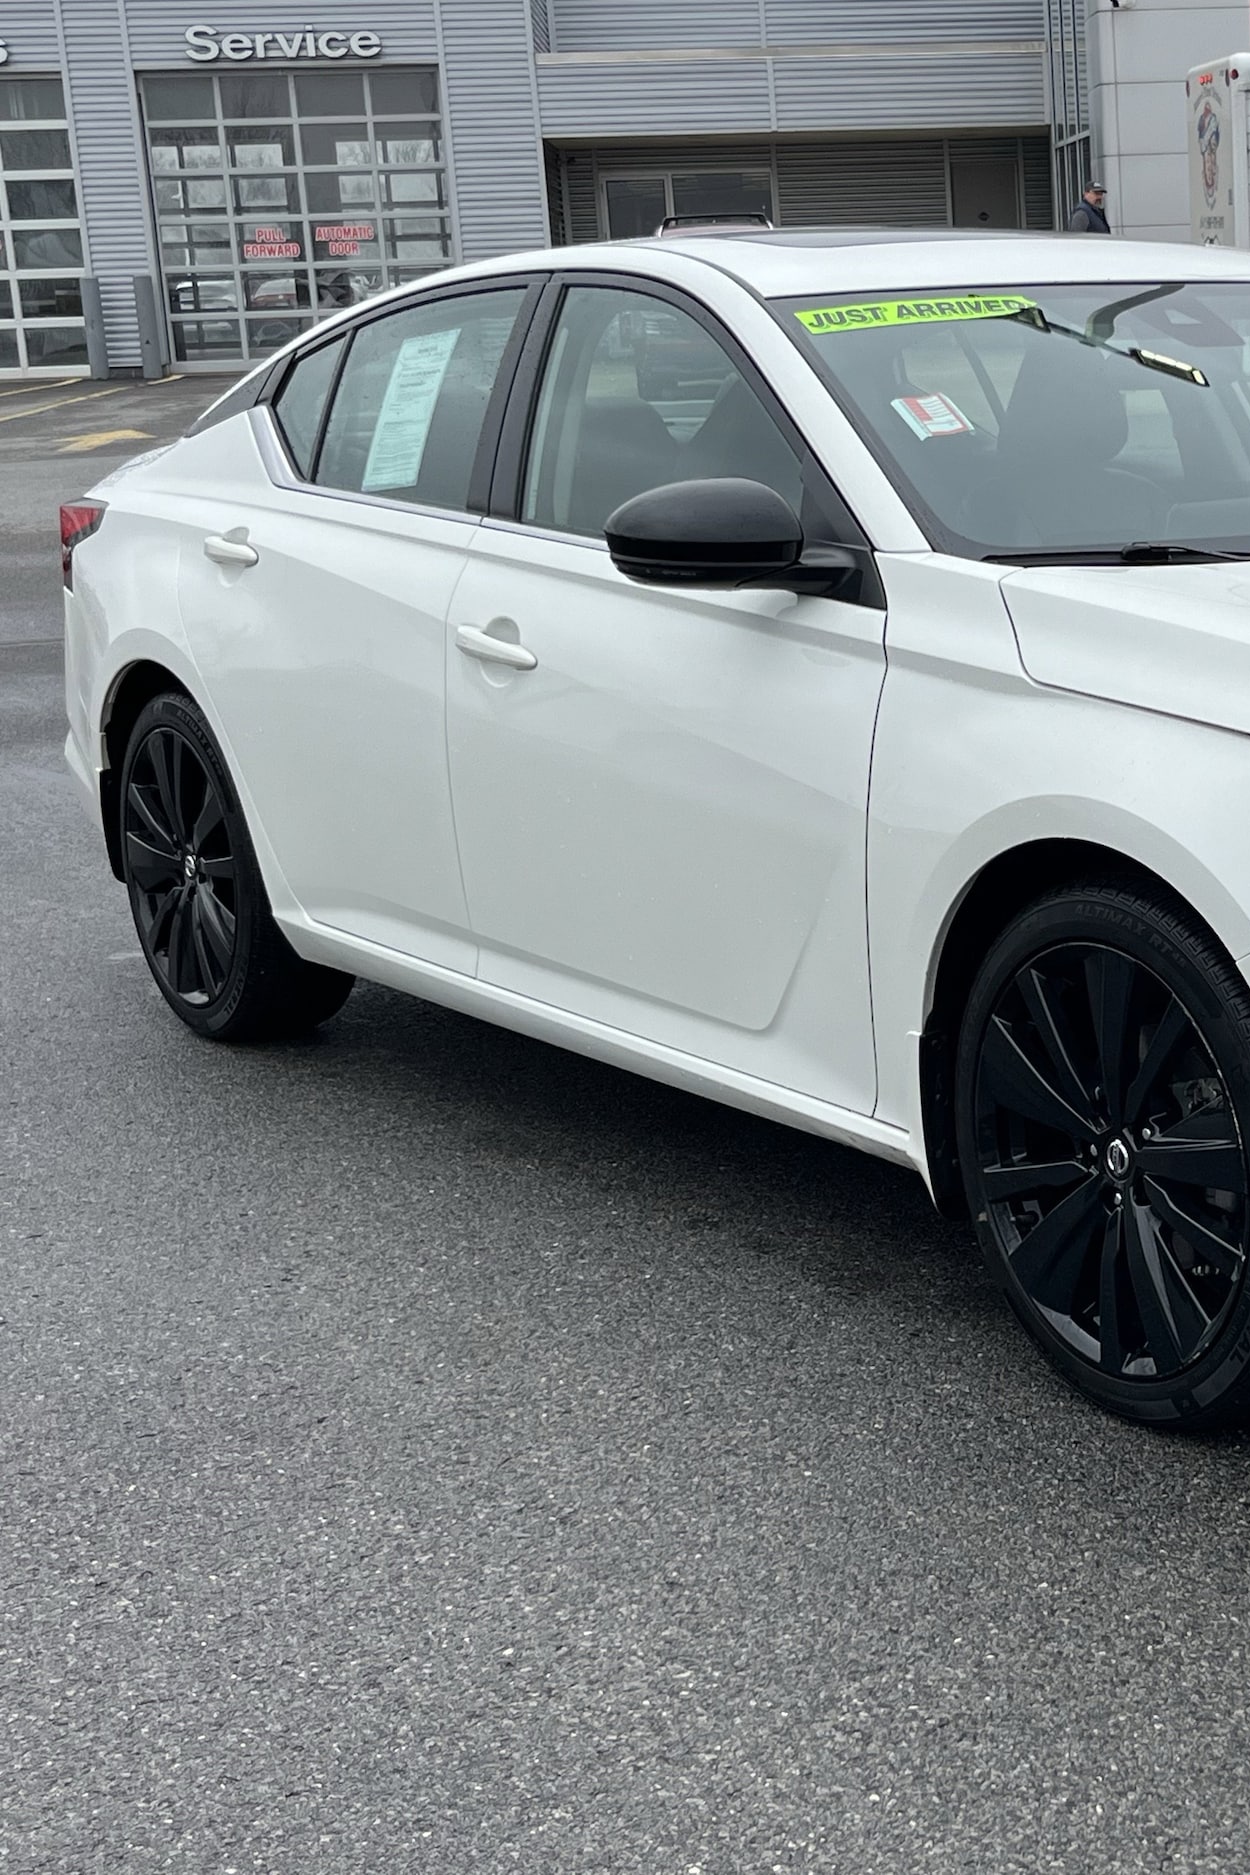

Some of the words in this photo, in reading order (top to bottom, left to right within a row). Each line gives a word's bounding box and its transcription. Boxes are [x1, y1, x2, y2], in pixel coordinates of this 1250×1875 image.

[185, 24, 382, 62] Service
[256, 228, 287, 242] PULL
[315, 226, 374, 241] AUTOMATIC
[244, 243, 300, 258] FORWARD
[329, 241, 360, 256] DOOR
[808, 306, 884, 328] JUST
[897, 299, 1025, 319] ARRIVED
[1074, 903, 1146, 936] ALTIMAX
